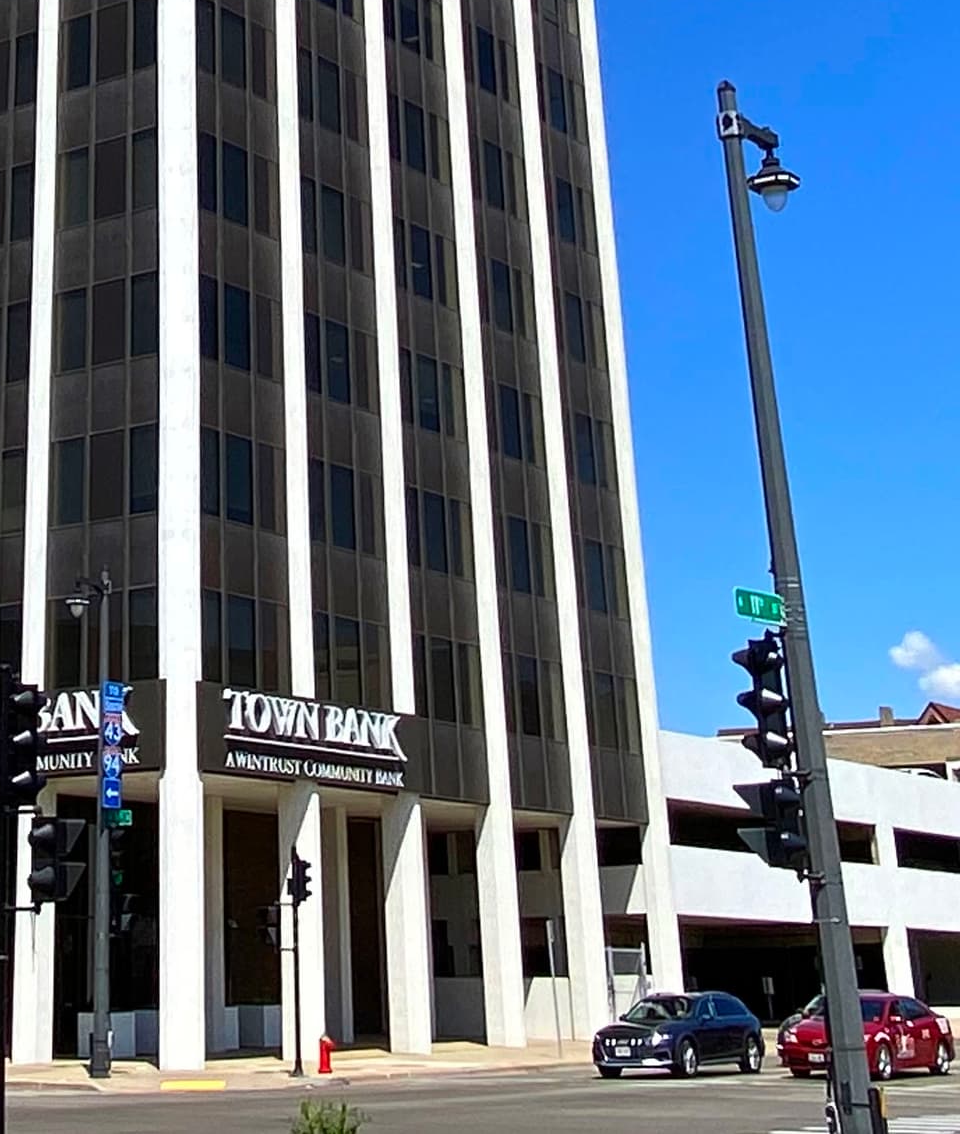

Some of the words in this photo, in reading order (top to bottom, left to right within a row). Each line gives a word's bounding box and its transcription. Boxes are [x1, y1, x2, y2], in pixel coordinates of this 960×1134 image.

[105, 722, 121, 740] 43
[223, 688, 320, 741] TOWN
[324, 705, 408, 762] BANK
[36, 751, 94, 771] MUNITY
[121, 747, 140, 764] NK
[103, 754, 120, 772] 94
[225, 751, 236, 768] A
[235, 751, 302, 775] WINTRUST
[375, 769, 404, 787] BANK
